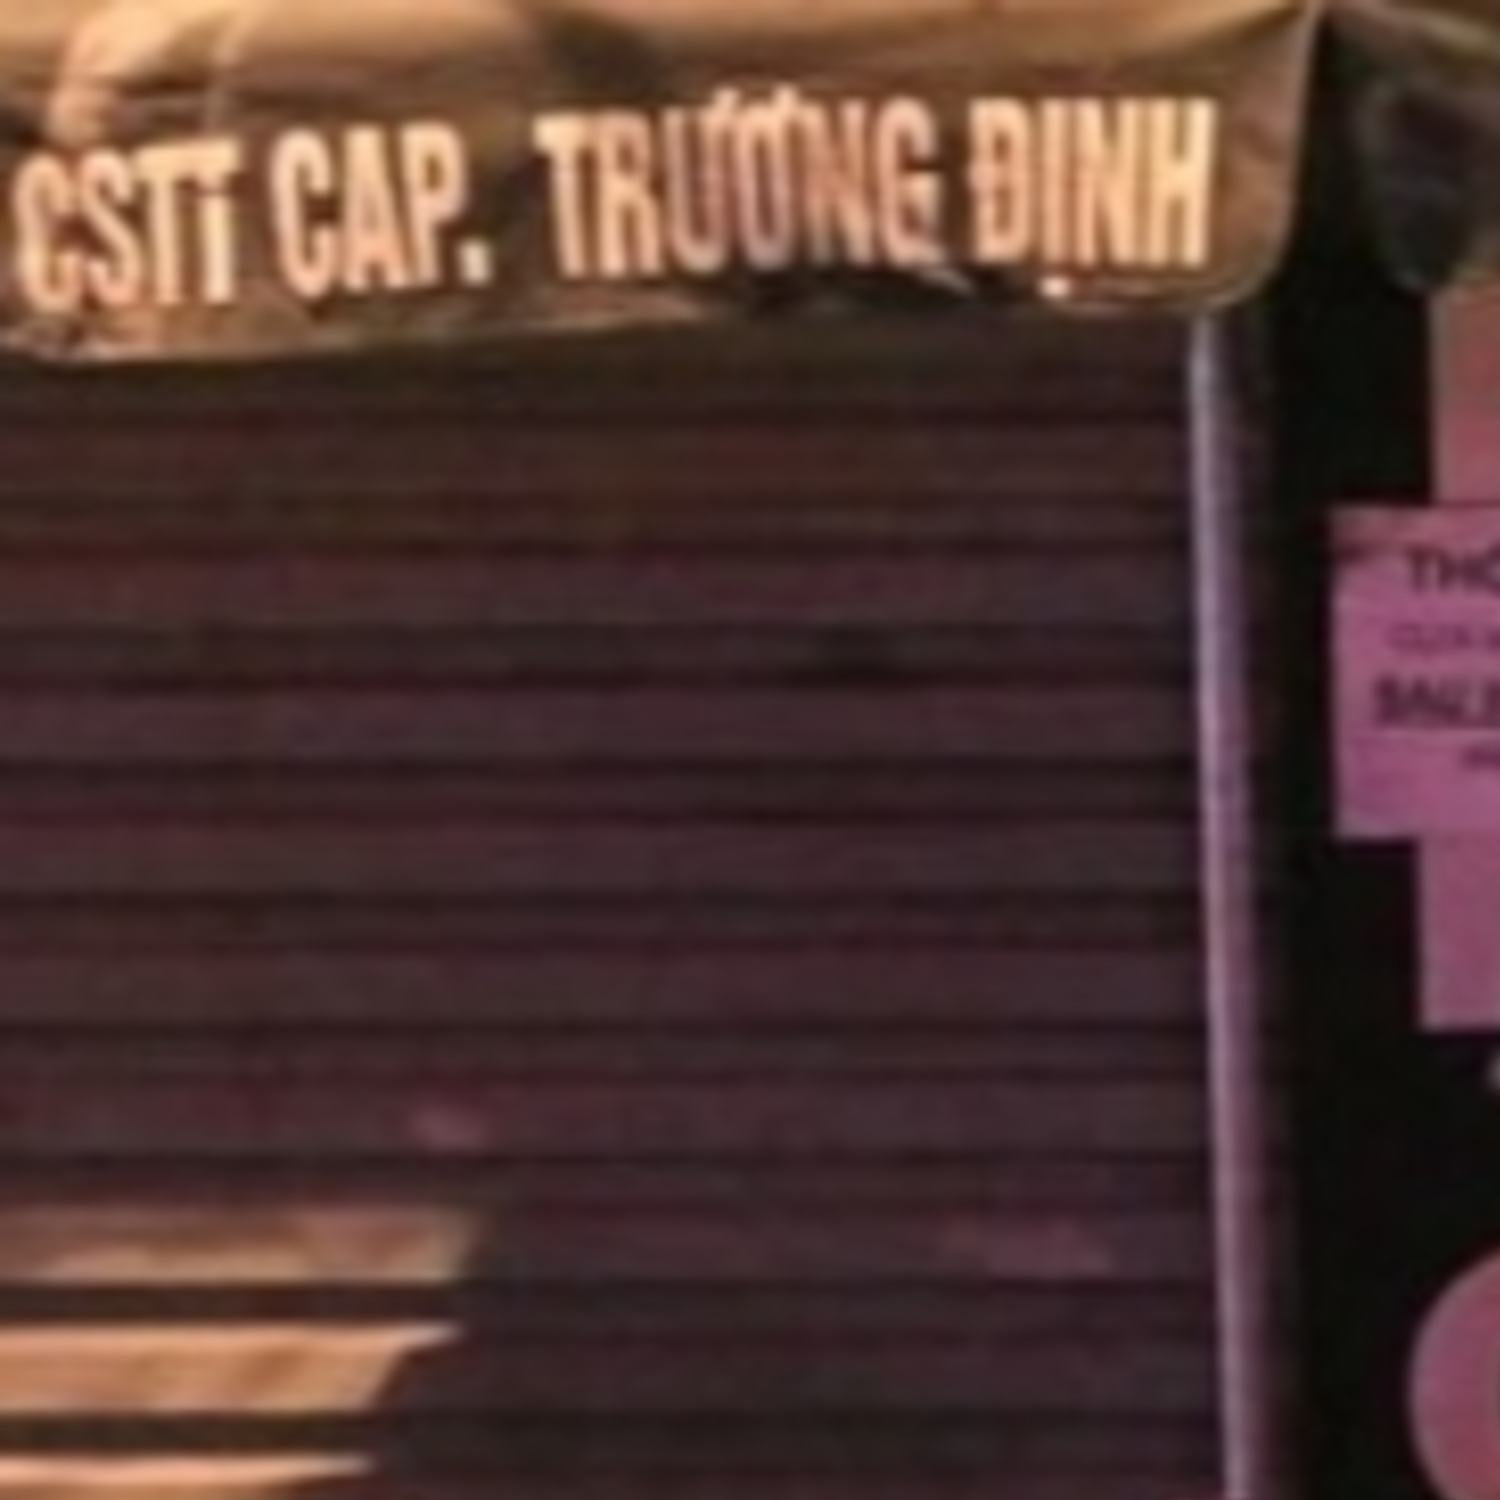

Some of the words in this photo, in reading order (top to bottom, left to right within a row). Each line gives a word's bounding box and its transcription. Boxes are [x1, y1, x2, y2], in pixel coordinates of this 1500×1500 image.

[14, 135, 242, 312] CSTT
[269, 120, 492, 300] CAP.
[967, 95, 1218, 300] ĐỊNH
